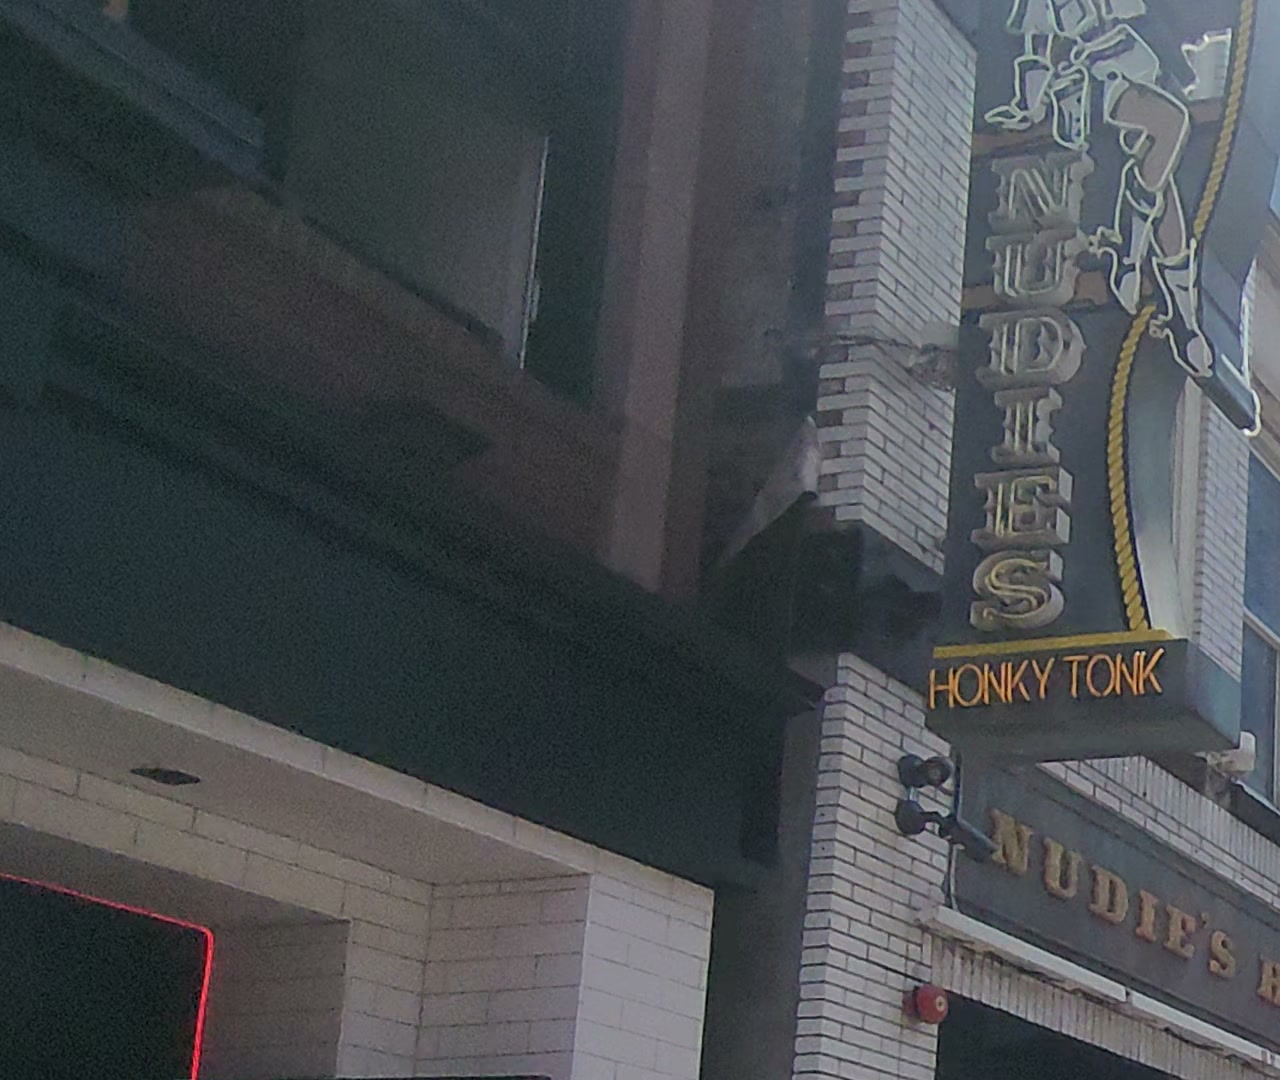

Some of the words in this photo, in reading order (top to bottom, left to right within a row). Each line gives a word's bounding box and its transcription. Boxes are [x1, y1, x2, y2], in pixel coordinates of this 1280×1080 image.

[969, 150, 1095, 631] NUDIES
[928, 657, 1055, 709] HONKY
[1063, 648, 1165, 698] TONK
[989, 808, 1237, 978] NUDIE'S
